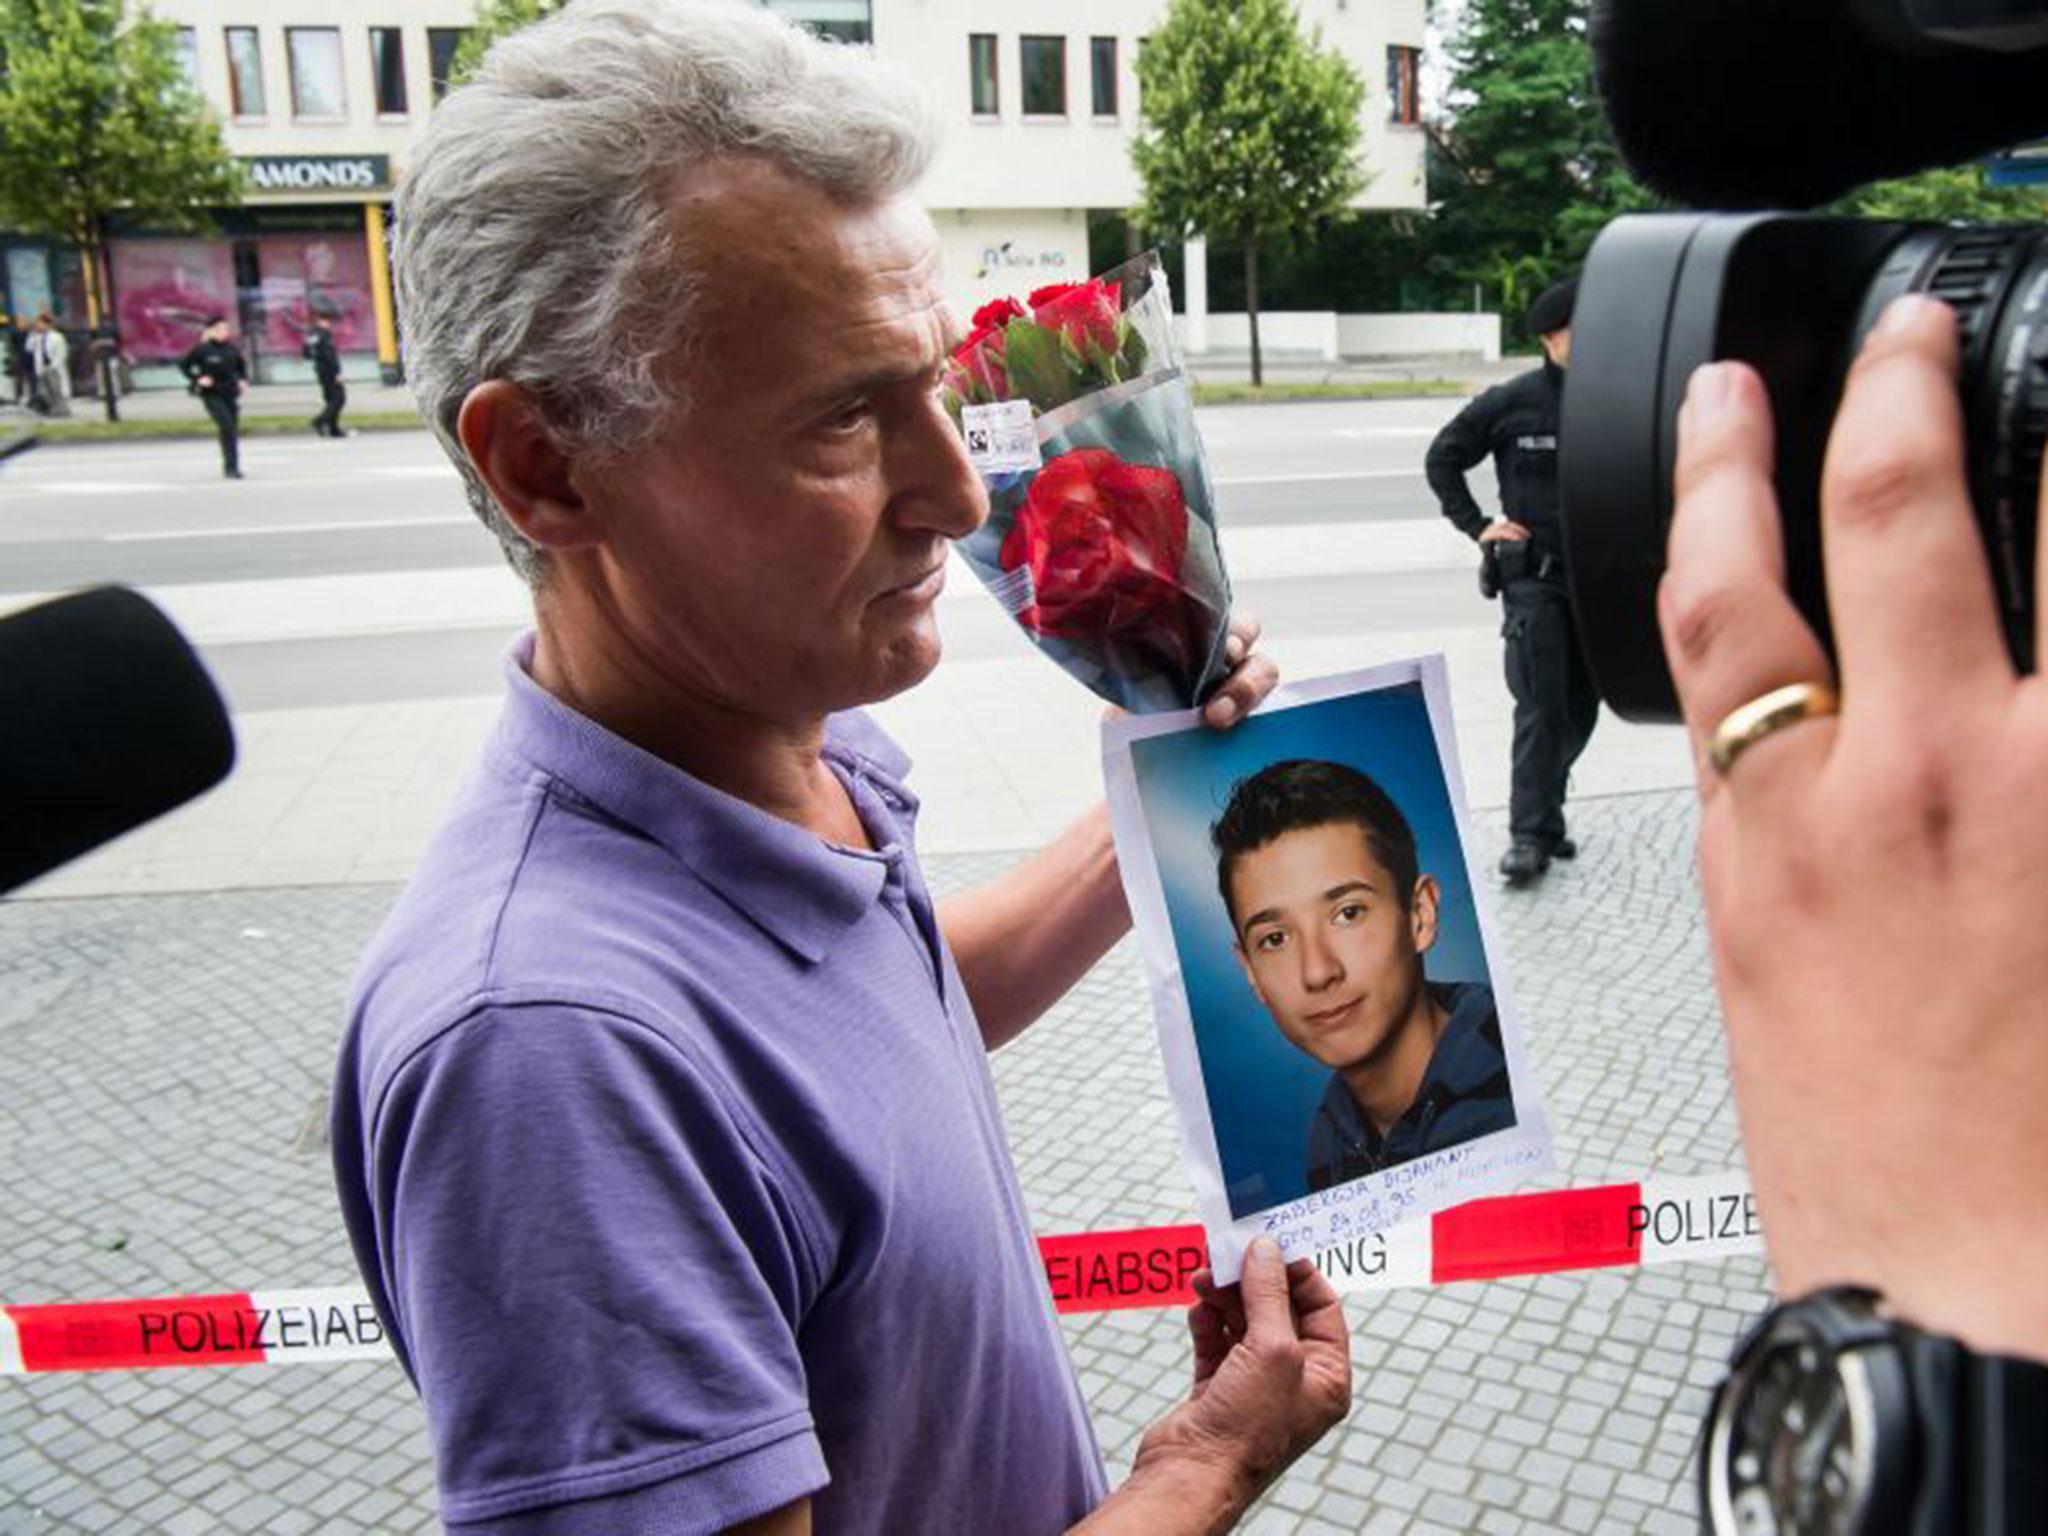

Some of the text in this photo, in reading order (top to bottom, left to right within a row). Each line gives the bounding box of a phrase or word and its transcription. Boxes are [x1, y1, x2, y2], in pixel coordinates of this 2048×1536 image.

[234, 158, 375, 188] AMONDS
[1626, 1193, 1764, 1248] POLIZE
[139, 1304, 383, 1354] POLIZEIAB
